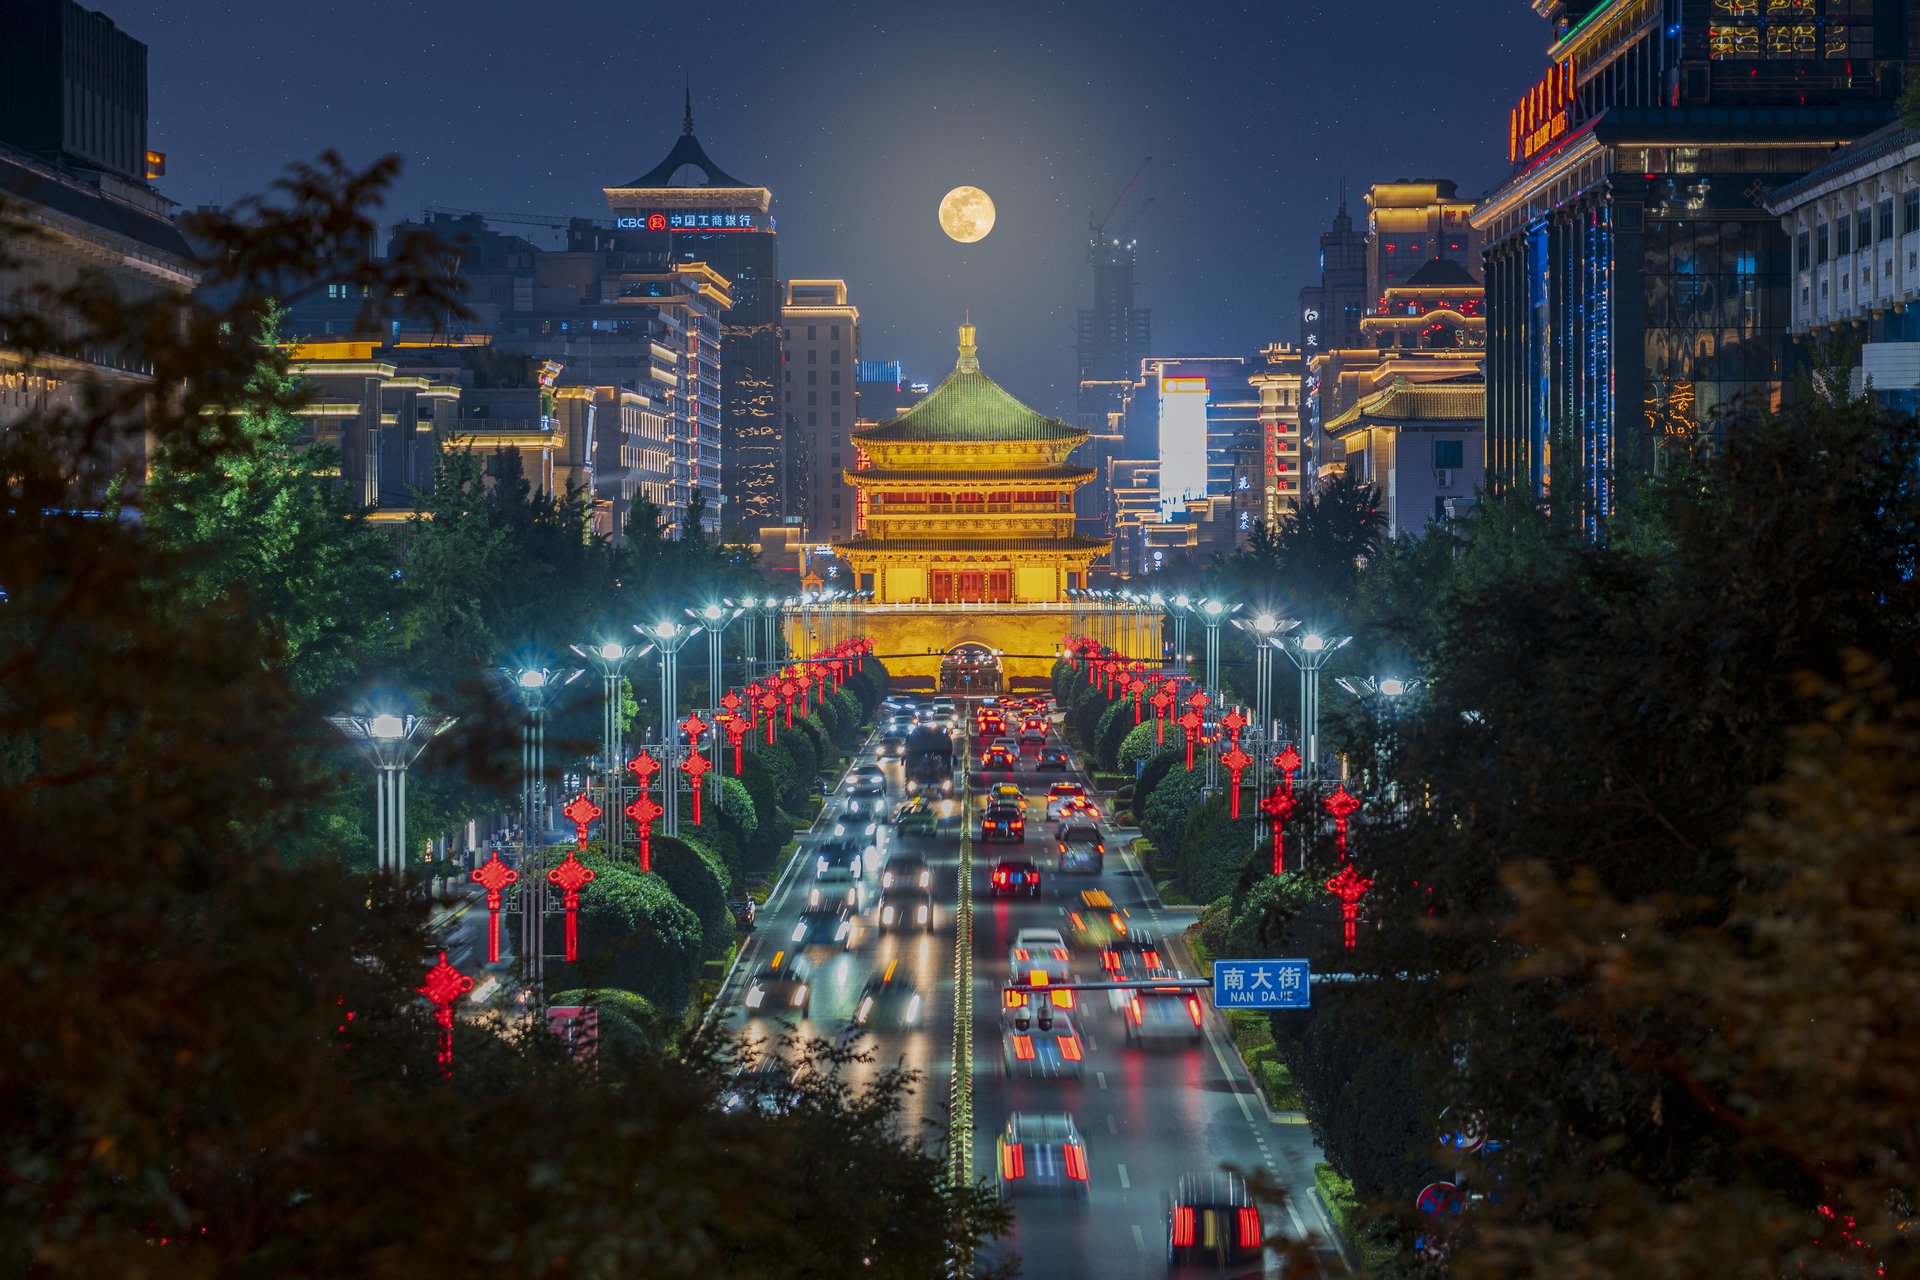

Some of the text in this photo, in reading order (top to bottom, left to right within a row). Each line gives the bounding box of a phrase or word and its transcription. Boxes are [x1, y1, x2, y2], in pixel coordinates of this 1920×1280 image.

[617, 217, 645, 228] ICBC
[1222, 966, 1301, 990] 南大街
[1230, 991, 1294, 1002] NAN DAJIE
